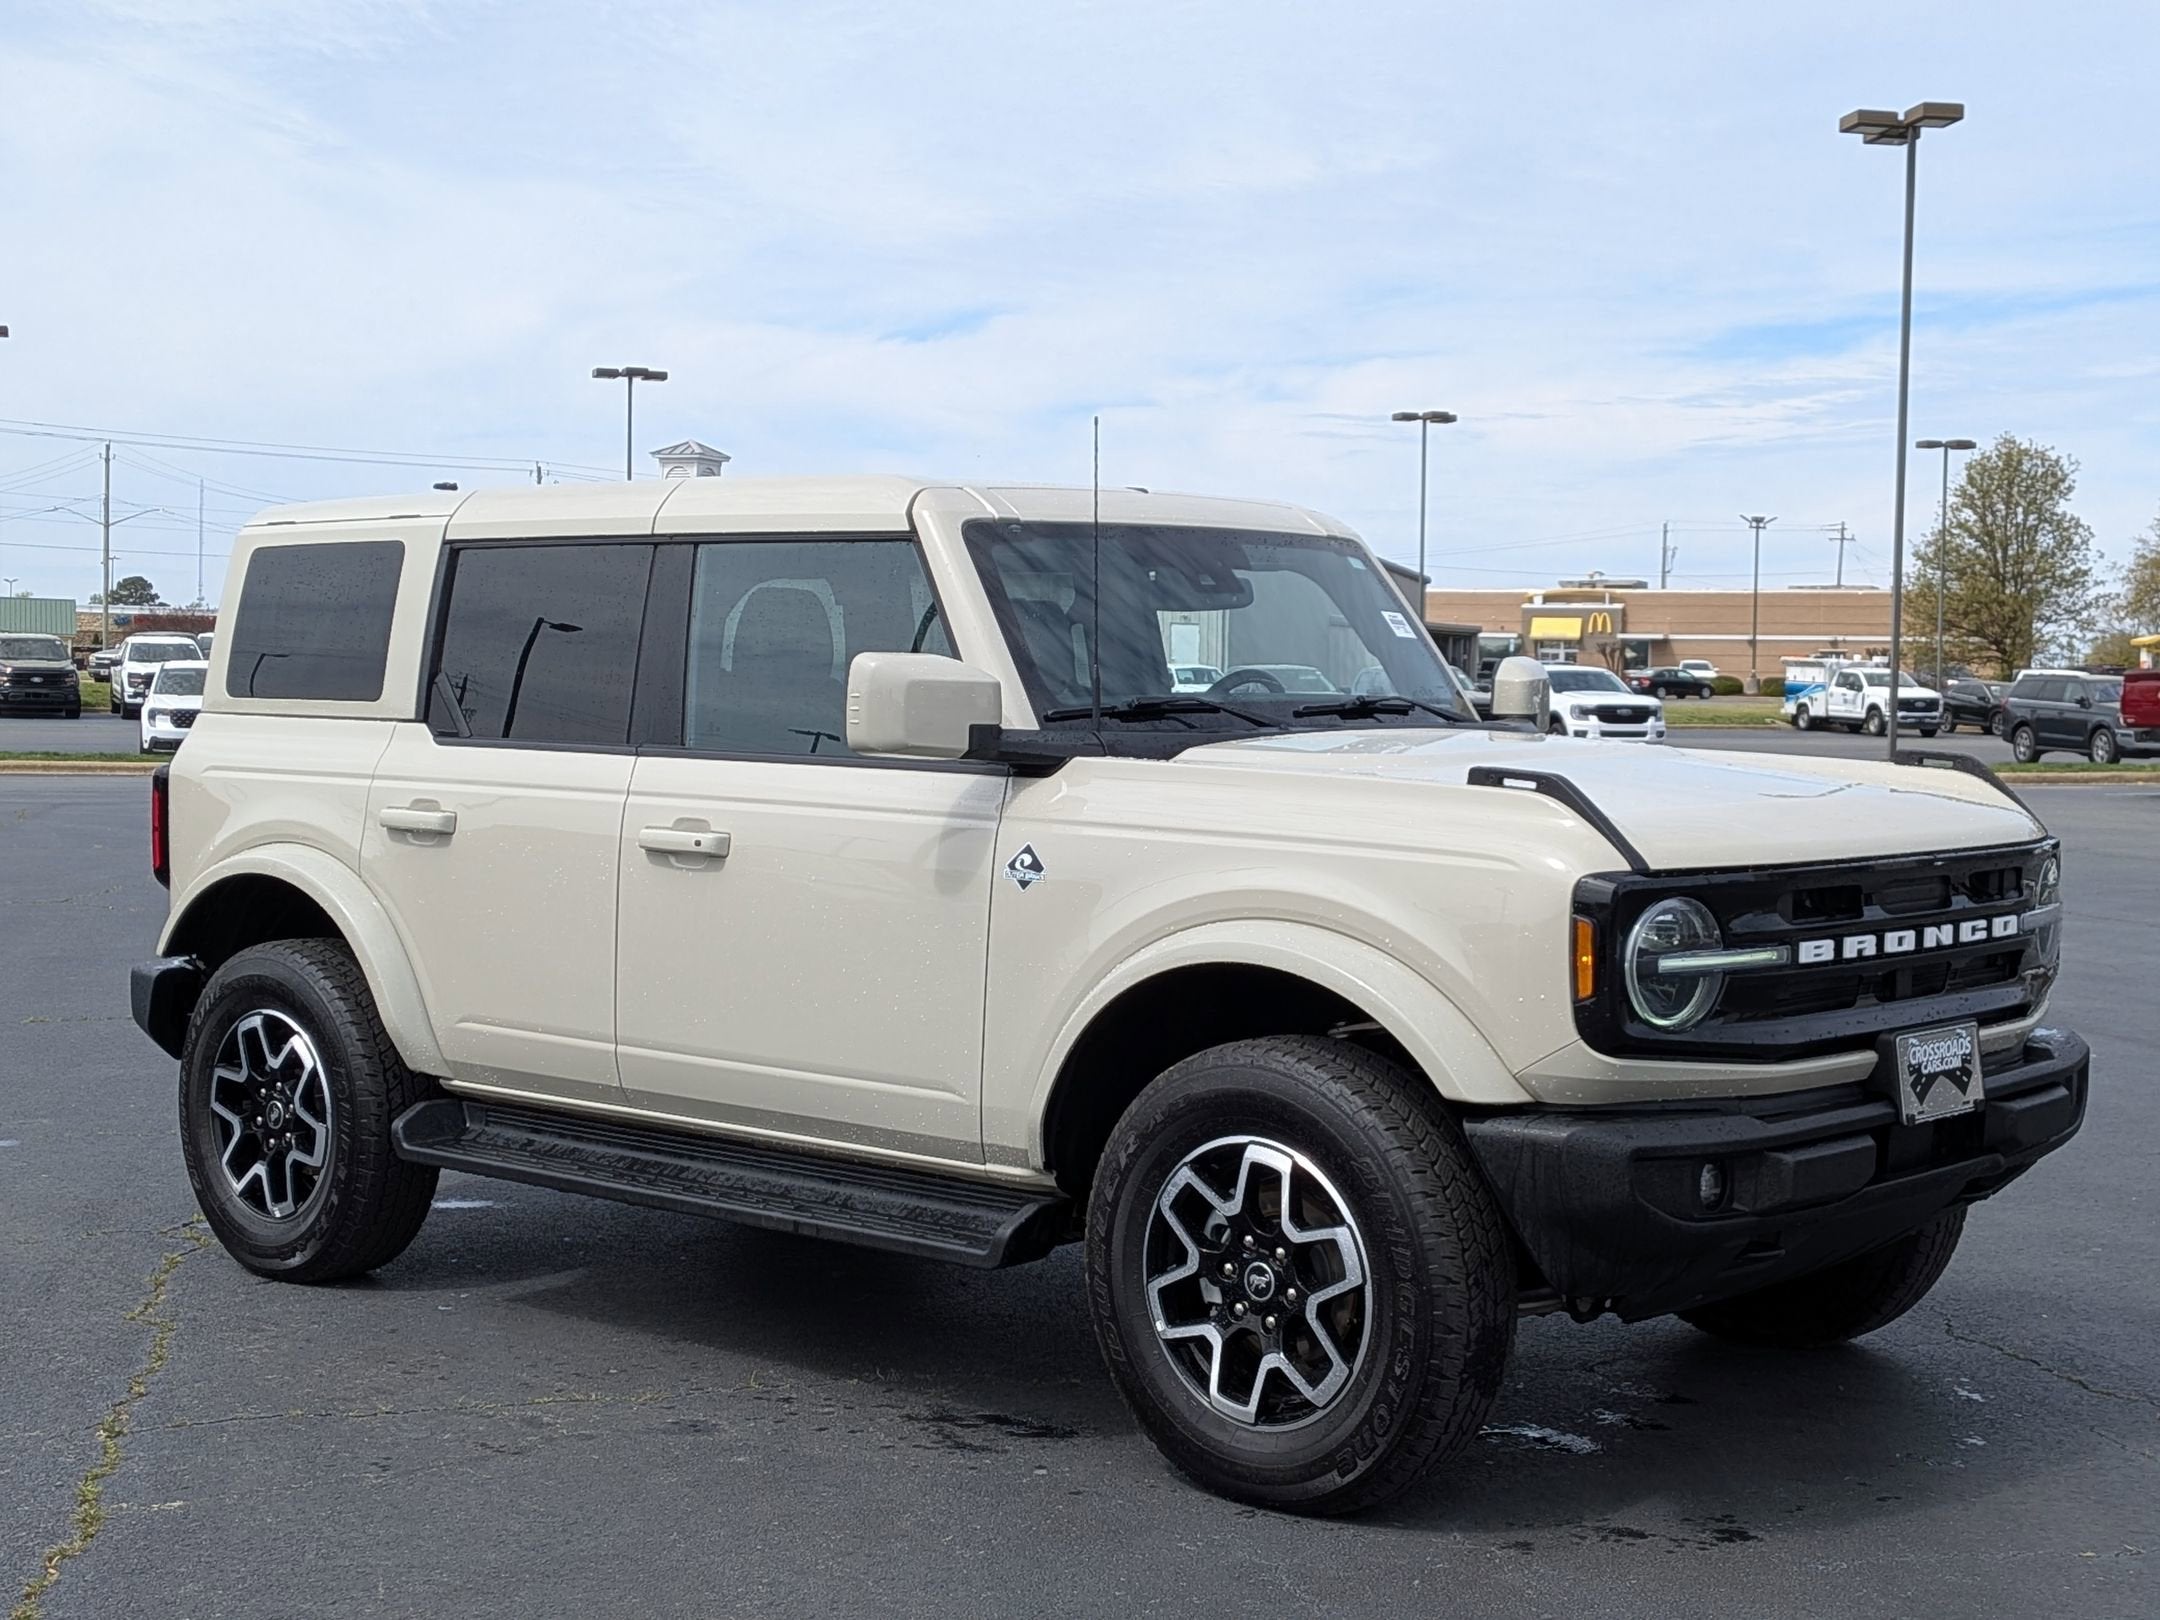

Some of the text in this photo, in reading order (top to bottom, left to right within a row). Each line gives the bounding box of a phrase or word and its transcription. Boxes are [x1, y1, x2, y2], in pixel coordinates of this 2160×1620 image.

[1798, 914, 2018, 964] BRONCO
[1909, 1036, 1972, 1064] CROSSROADS
[1921, 1055, 1962, 1075] CARS.COM
